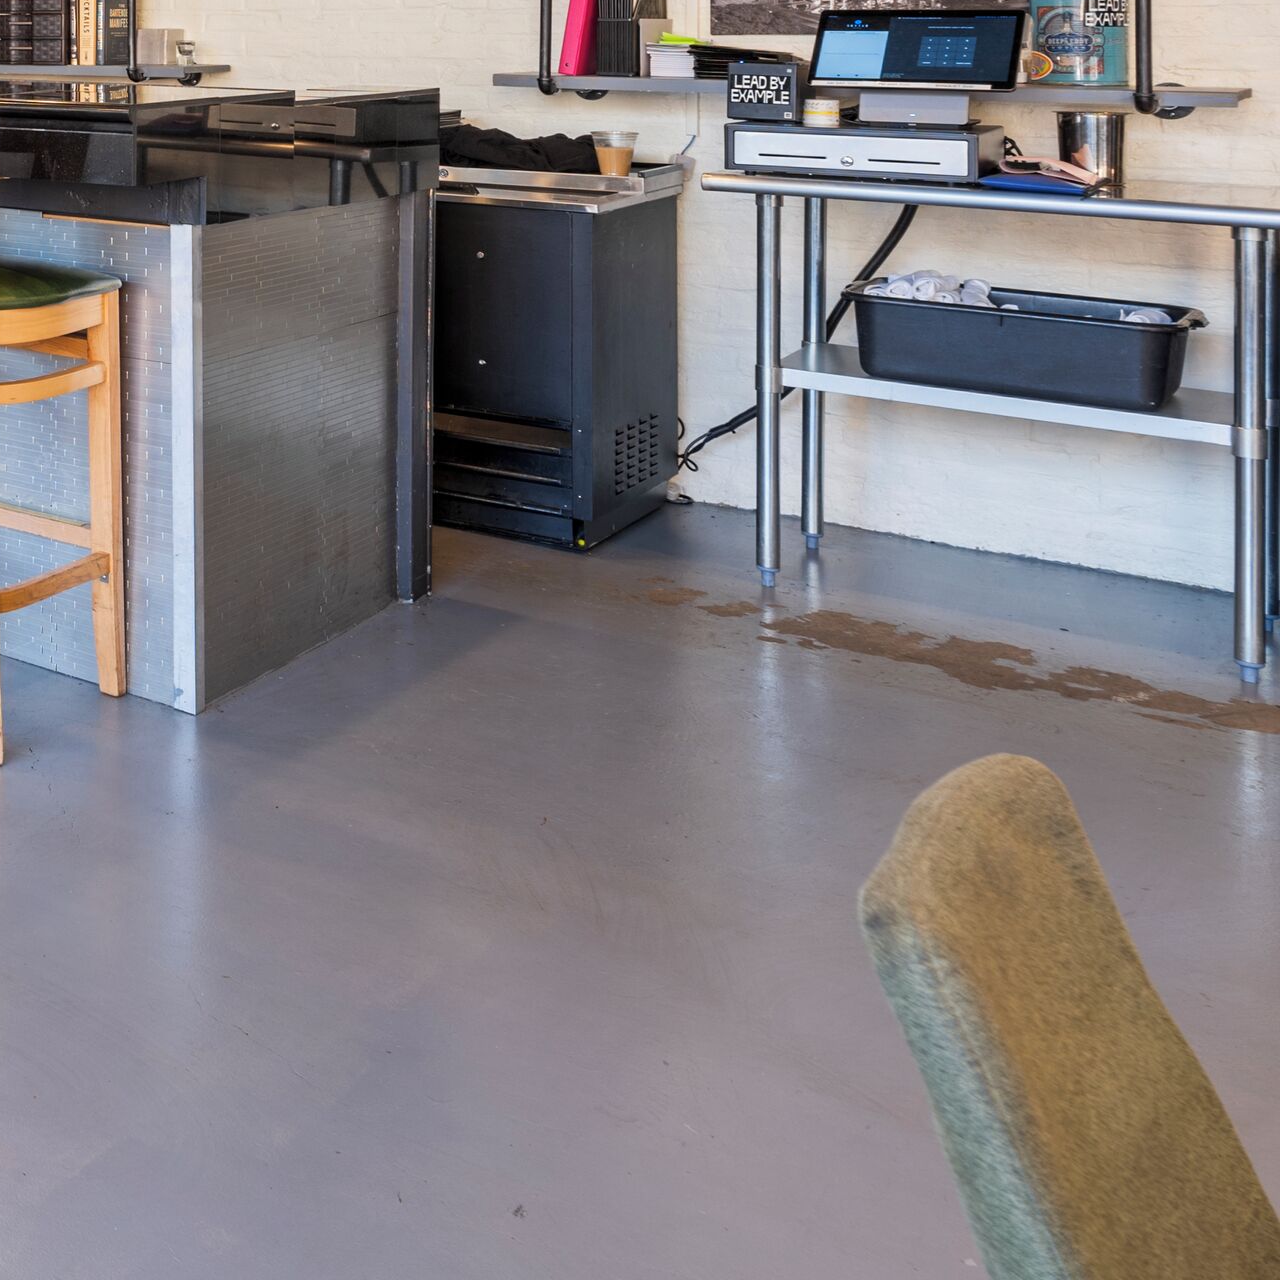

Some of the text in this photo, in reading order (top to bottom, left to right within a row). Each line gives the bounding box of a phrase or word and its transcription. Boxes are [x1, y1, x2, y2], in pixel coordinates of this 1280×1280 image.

[109, 17, 129, 28] MANIFES
[734, 75, 787, 91] LEAD BY
[730, 88, 790, 105] EXAMPLE
